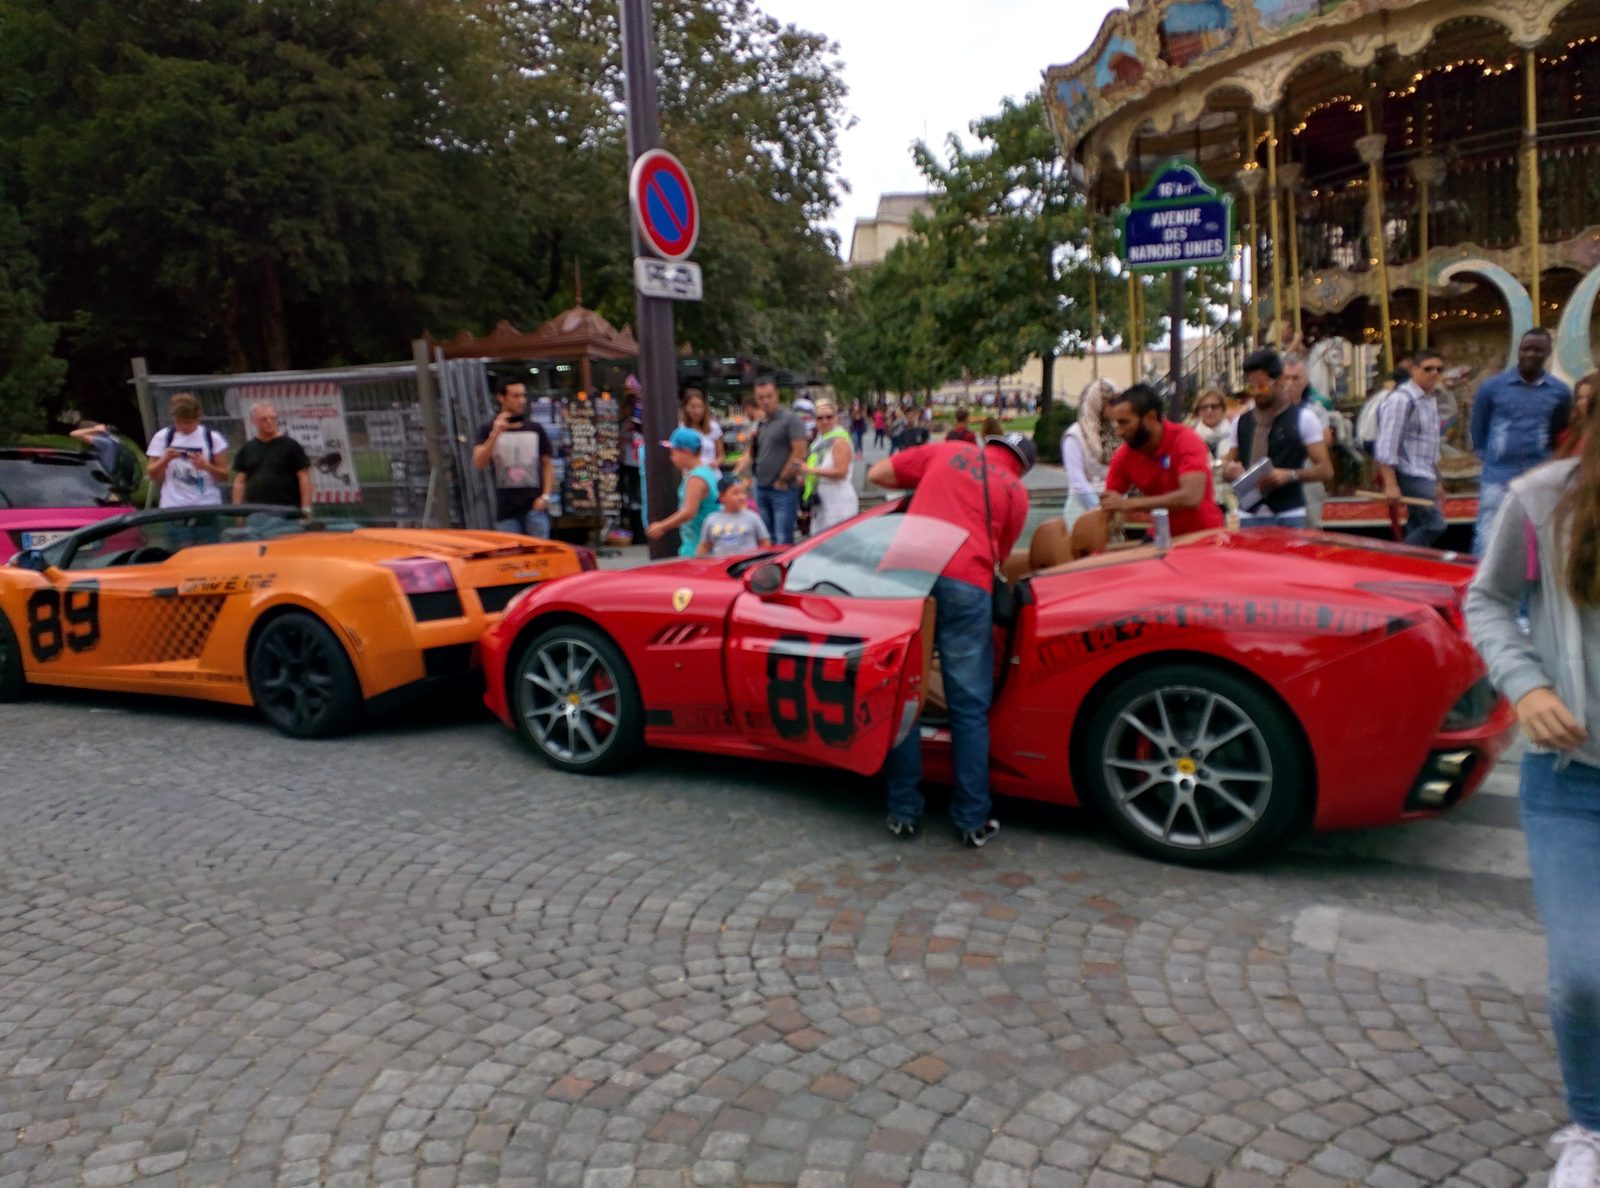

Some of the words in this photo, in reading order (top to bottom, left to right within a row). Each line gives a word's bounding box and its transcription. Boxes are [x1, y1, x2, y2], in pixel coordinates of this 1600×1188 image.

[1150, 208, 1201, 229] AVENUE
[1163, 227, 1188, 242] DES
[1129, 242, 1182, 262] NATIONS
[1183, 239, 1223, 258] UNIES
[28, 579, 100, 663] 89
[767, 633, 868, 748] 89
